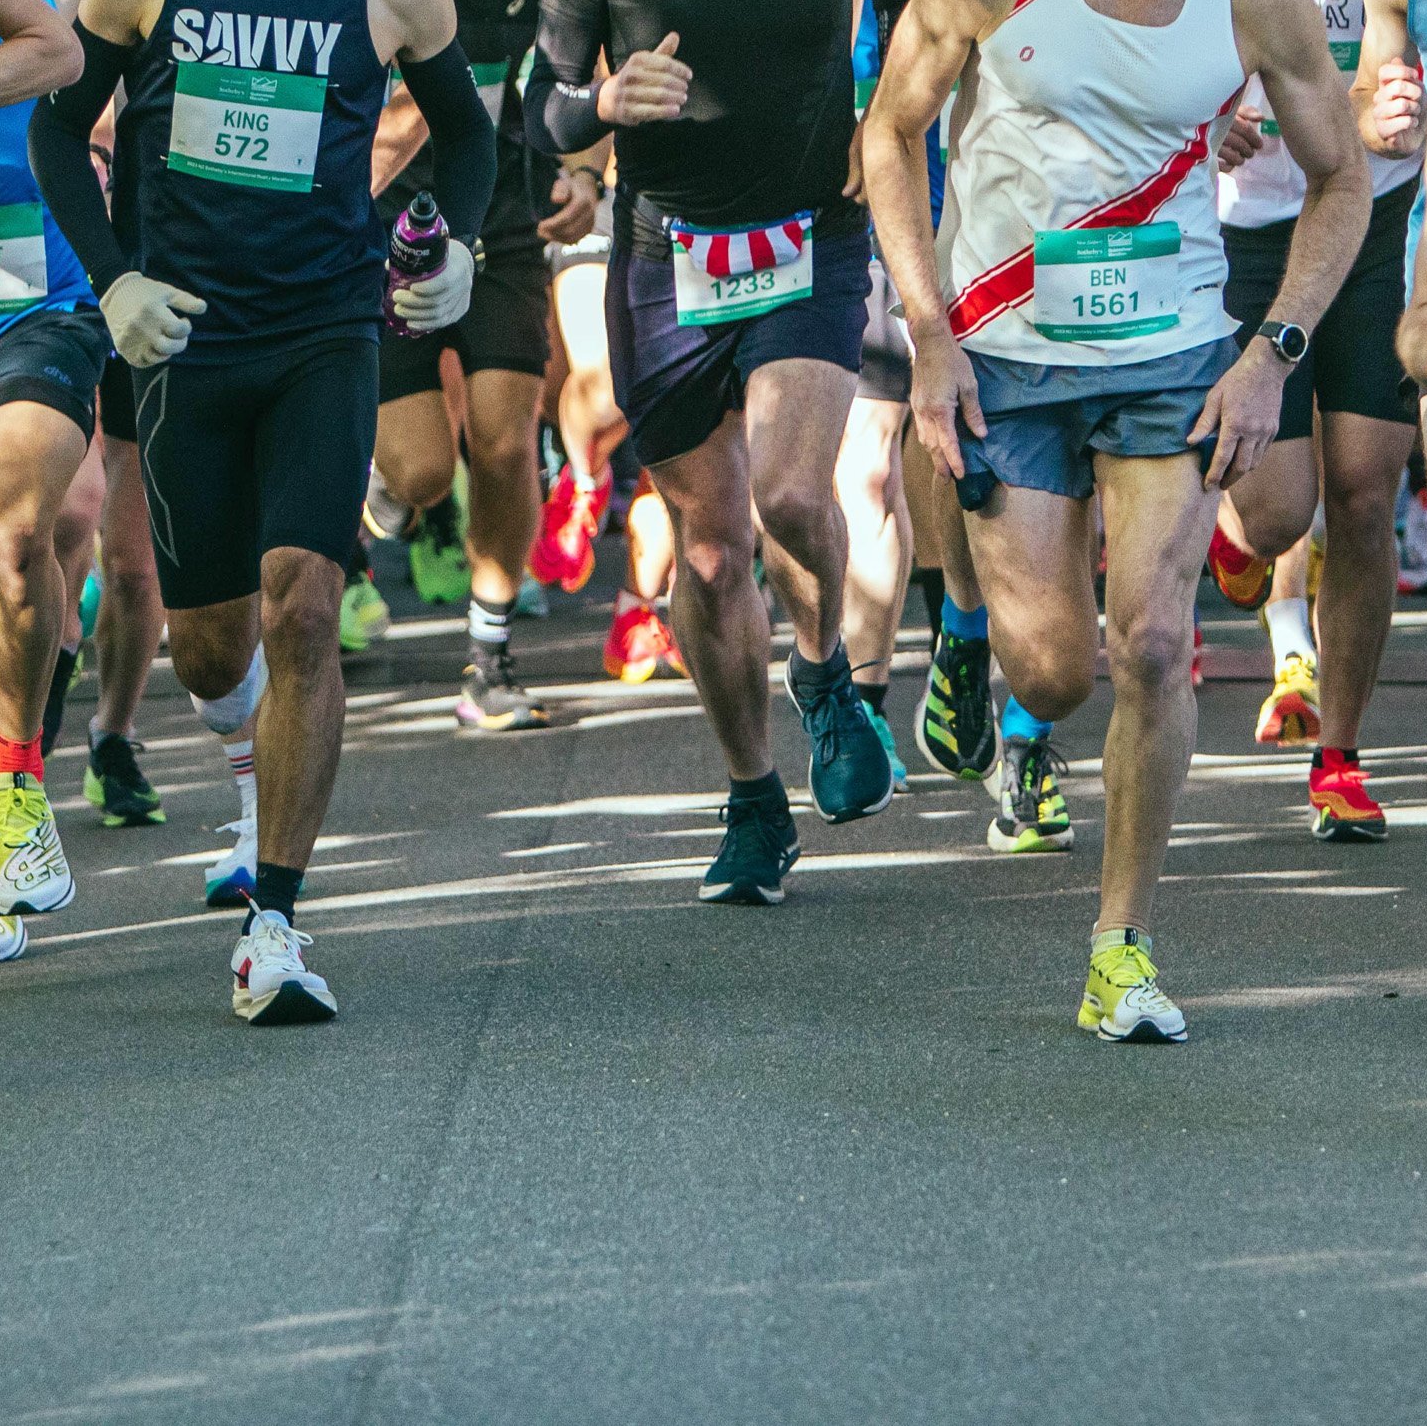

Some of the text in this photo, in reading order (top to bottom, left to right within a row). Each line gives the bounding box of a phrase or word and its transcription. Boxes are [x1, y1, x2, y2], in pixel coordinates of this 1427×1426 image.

[171, 8, 343, 76] SAVVY
[223, 109, 269, 132] KING
[214, 133, 270, 162] 572
[710, 270, 776, 300] 1233
[1090, 267, 1127, 287] BEN
[1072, 291, 1139, 317] 1561
